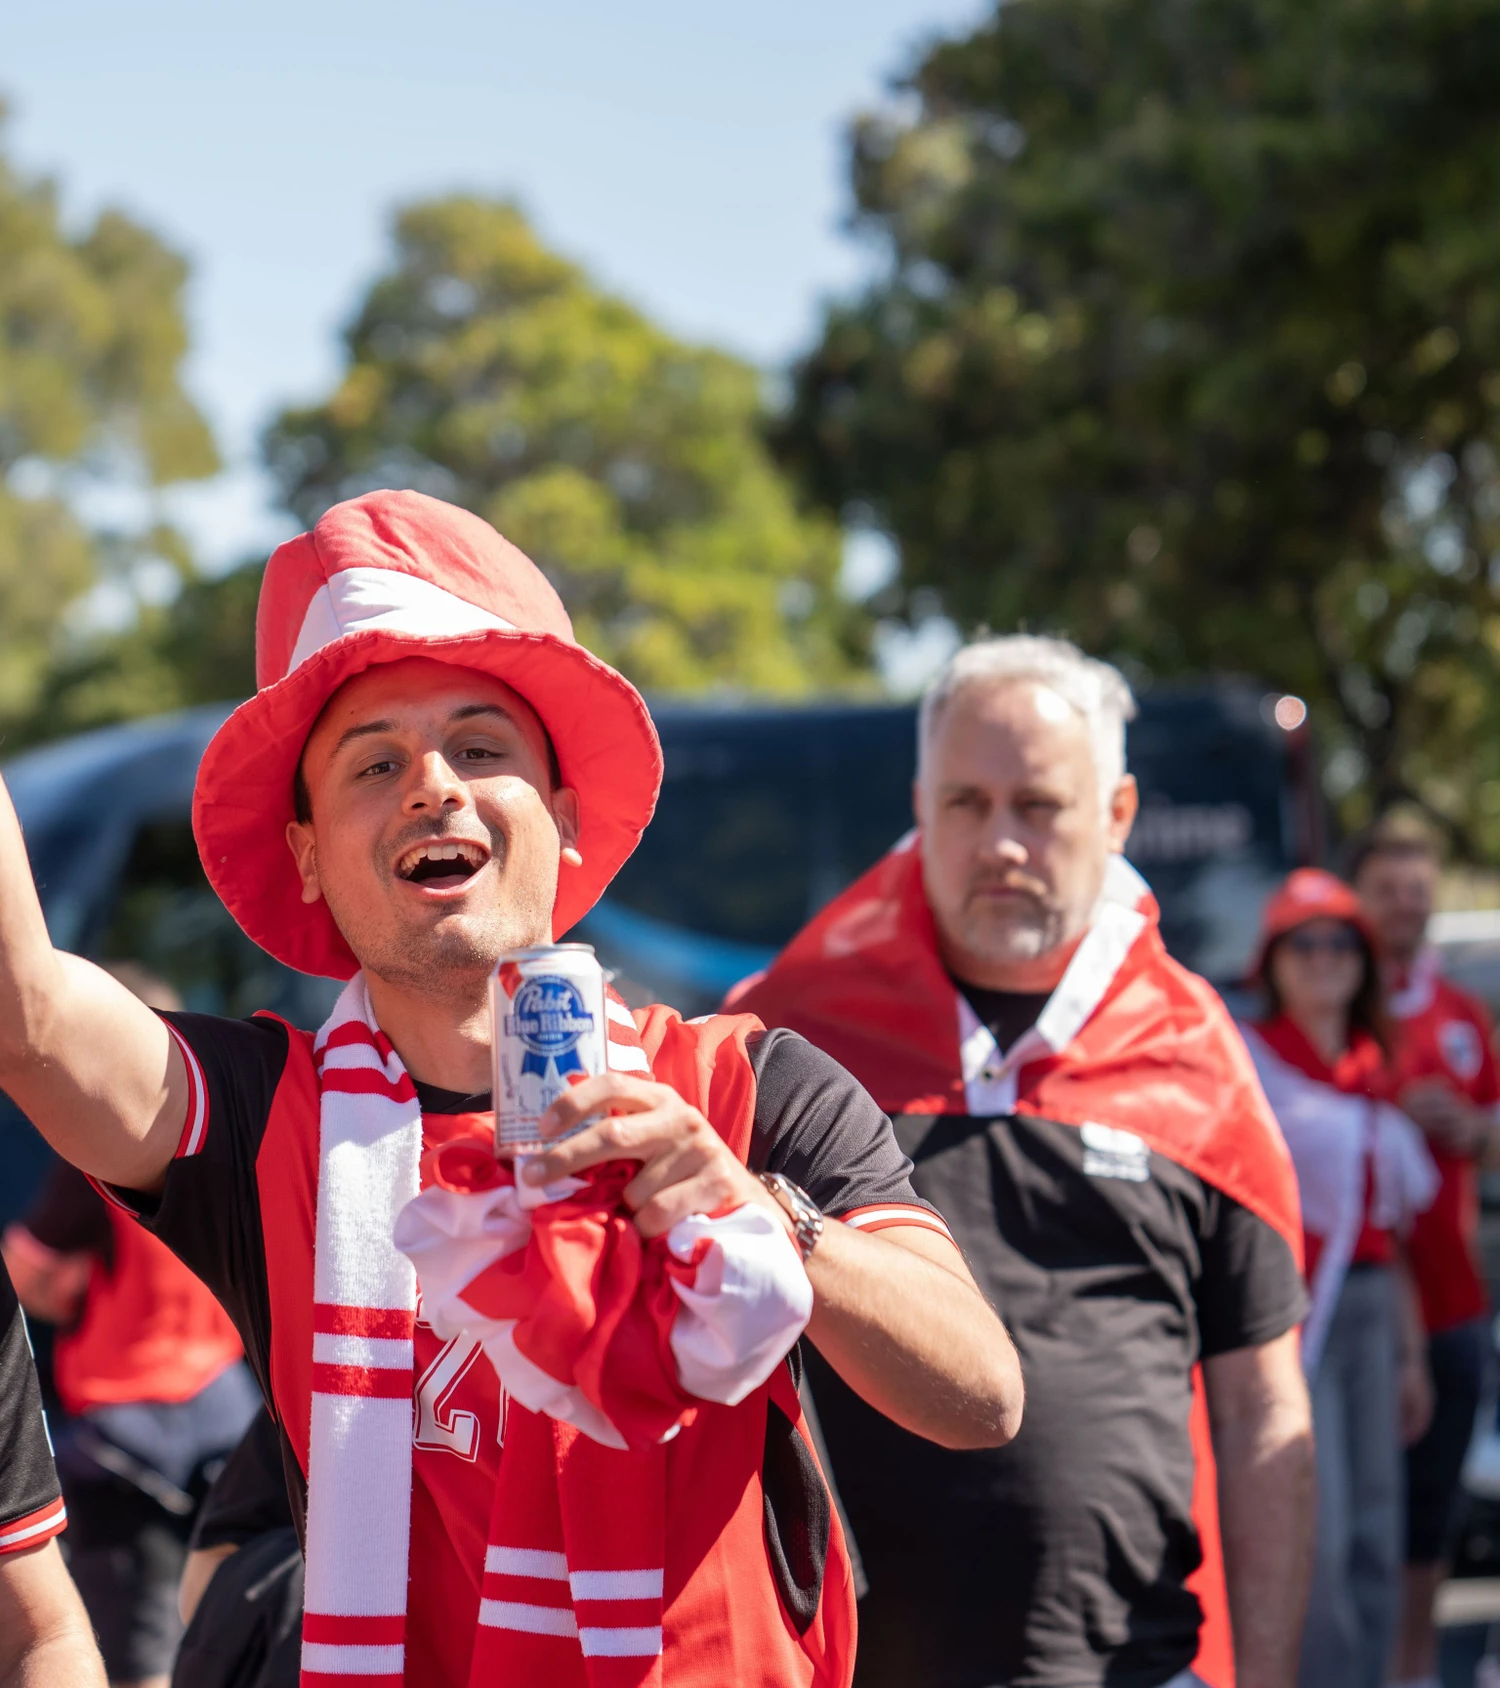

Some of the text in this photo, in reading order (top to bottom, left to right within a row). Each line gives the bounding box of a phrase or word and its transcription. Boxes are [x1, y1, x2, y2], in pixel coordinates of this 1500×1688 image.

[522, 985, 573, 1012] Pabst
[505, 1012, 594, 1037] Blue Ribbon
